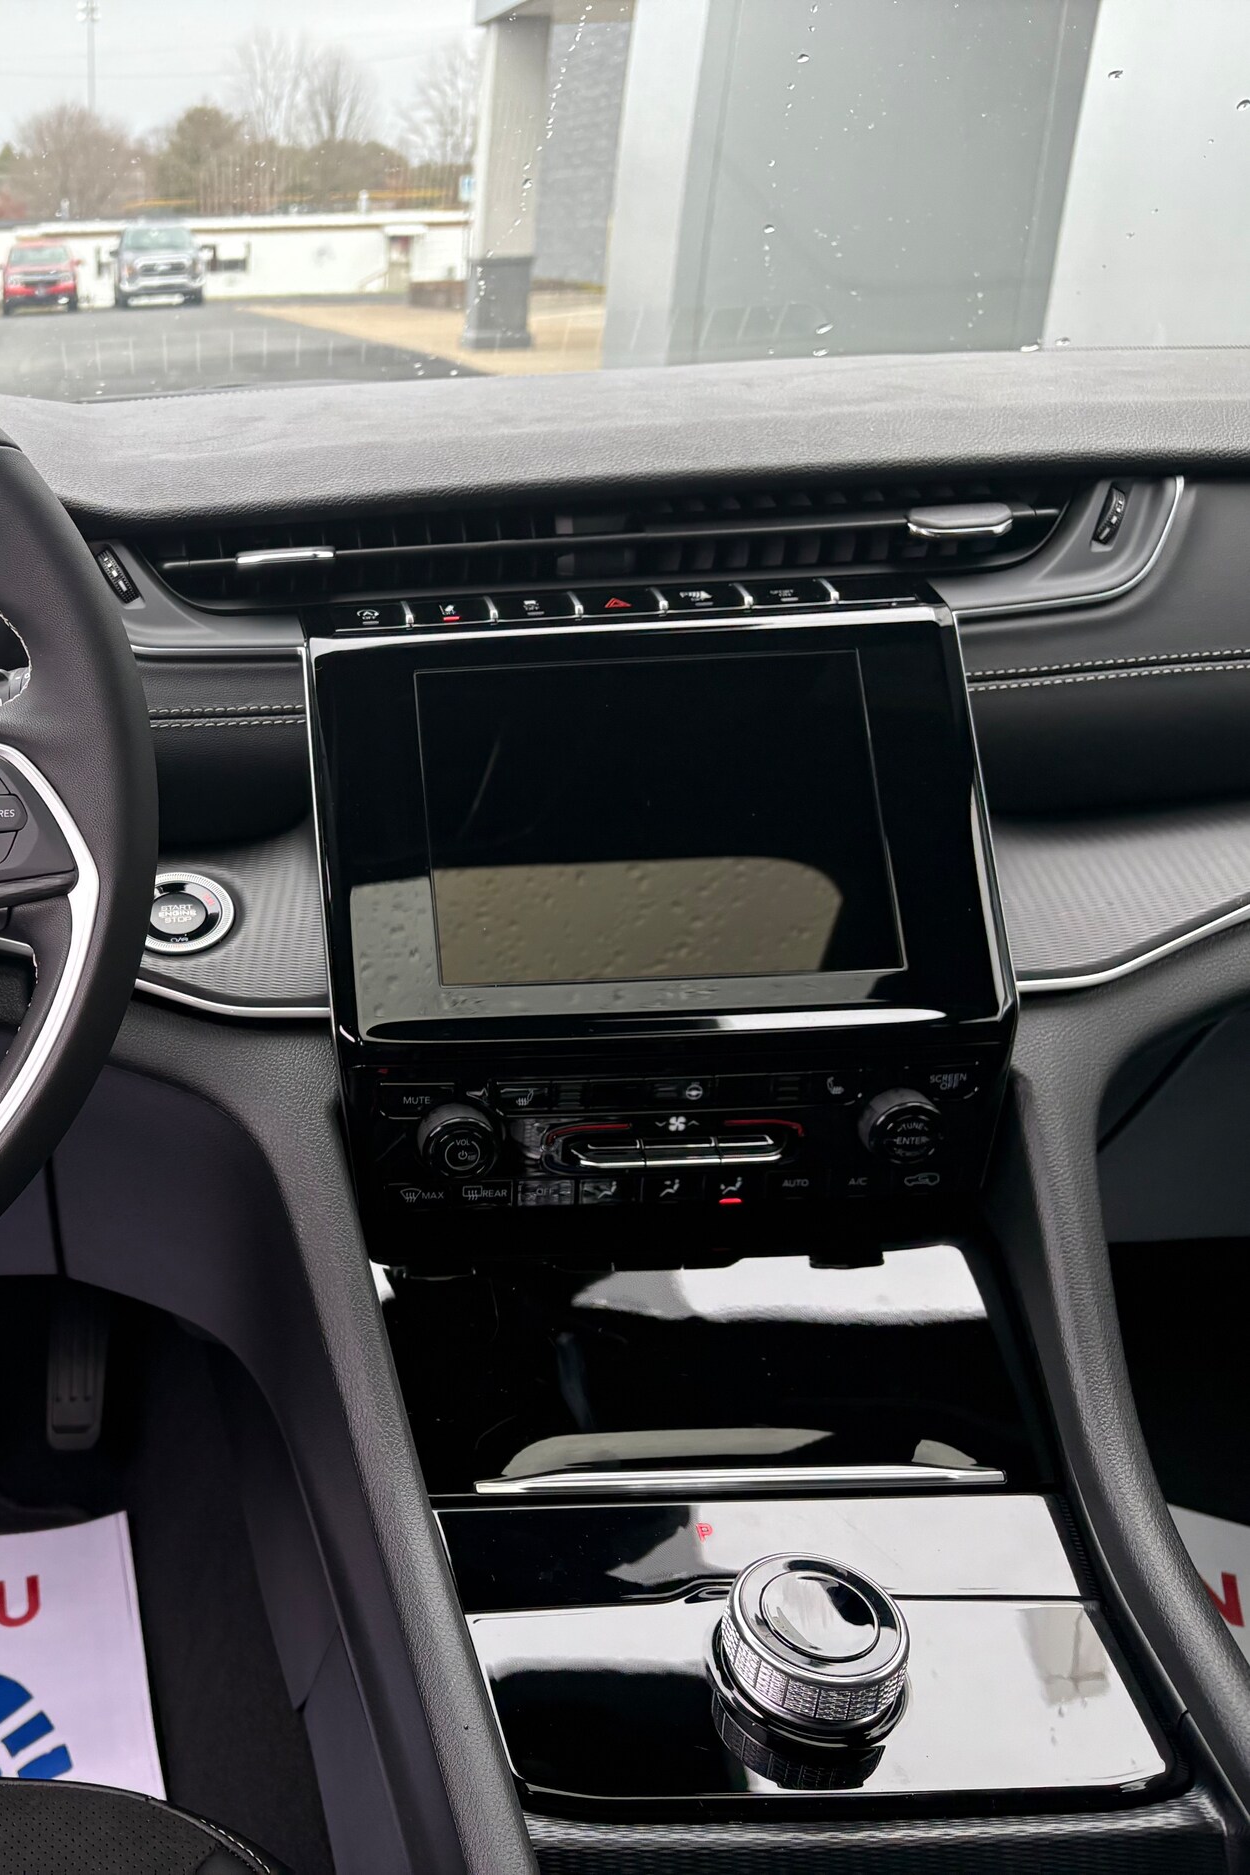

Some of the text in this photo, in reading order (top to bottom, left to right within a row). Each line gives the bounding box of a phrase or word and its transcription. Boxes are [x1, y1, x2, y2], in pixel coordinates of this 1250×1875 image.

[158, 909, 197, 918] ENGINE
[929, 1073, 967, 1084] SCREEN
[403, 1095, 431, 1105] MUTE
[902, 1122, 925, 1130] TUNE
[455, 1138, 471, 1146] VOL
[896, 1136, 927, 1145] ENTER
[782, 1178, 809, 1188] AUTO
[848, 1177, 868, 1186] A/C
[422, 1191, 444, 1200] MAX
[482, 1189, 508, 1198] REAR
[695, 1523, 713, 1543] P
